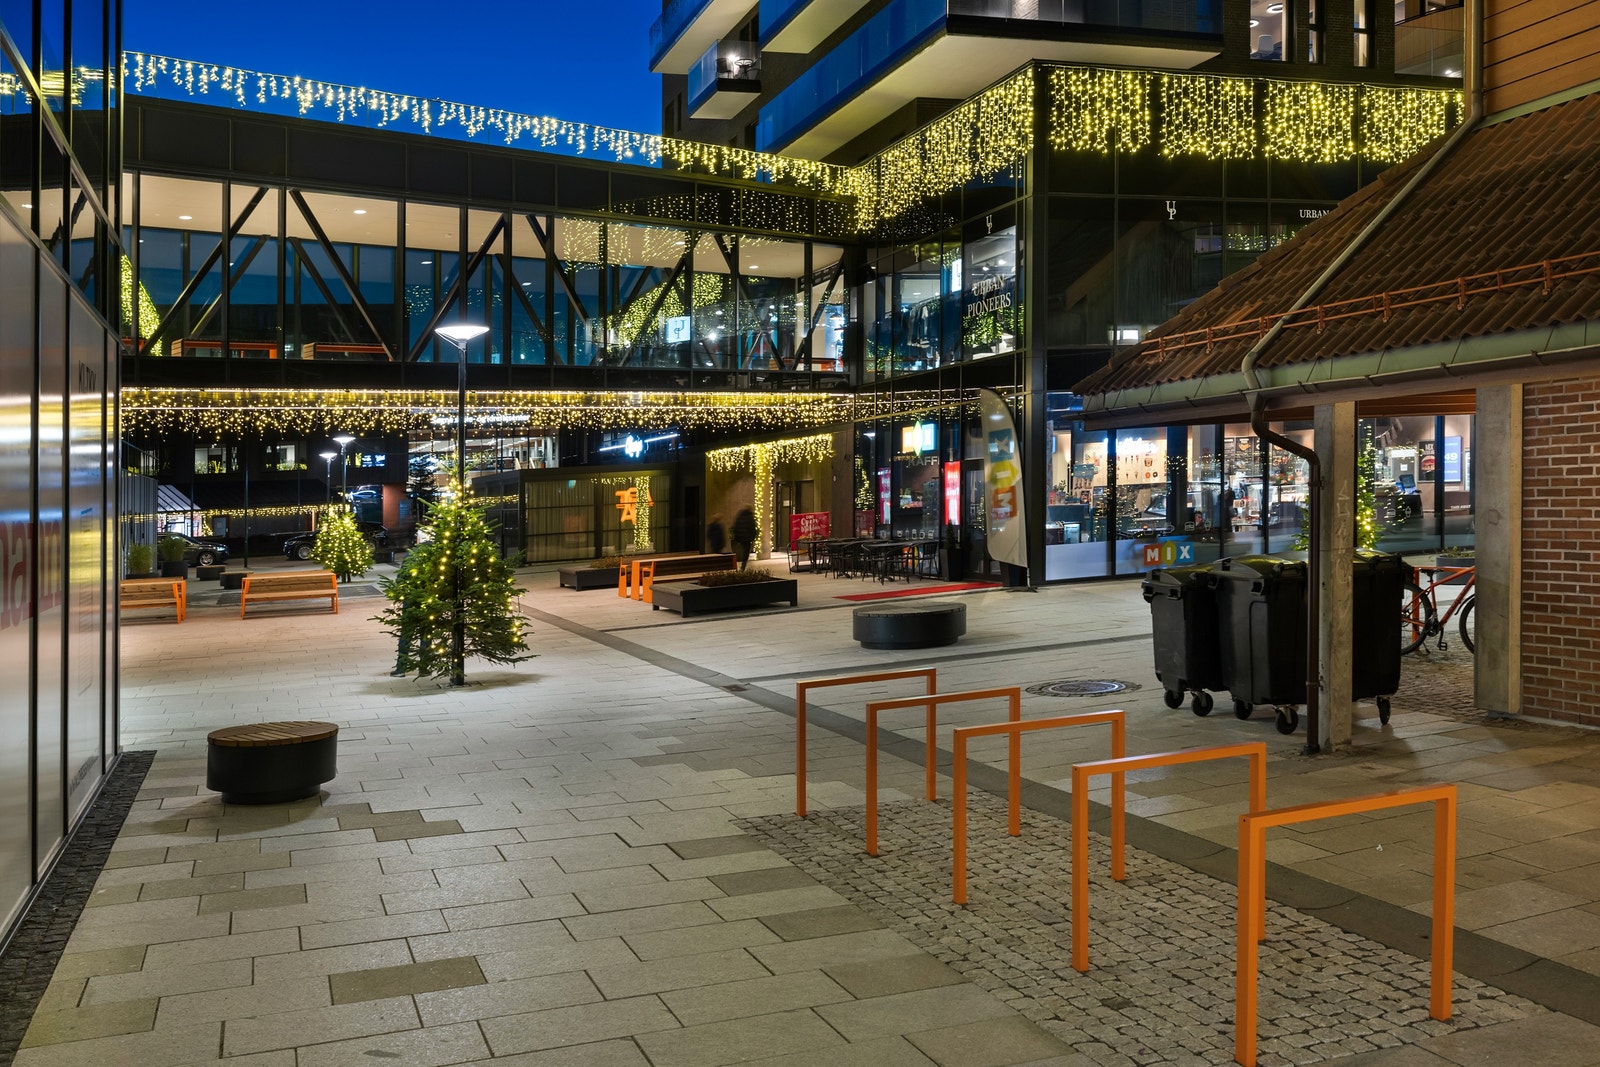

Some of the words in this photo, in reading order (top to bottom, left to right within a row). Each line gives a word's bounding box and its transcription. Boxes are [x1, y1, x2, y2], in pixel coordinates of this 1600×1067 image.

[972, 273, 1006, 297] URBAN
[967, 292, 1012, 318] PIONEERS
[908, 456, 940, 467] KAFF
[994, 436, 1013, 515] MIX
[1146, 545, 1191, 562] MIX
